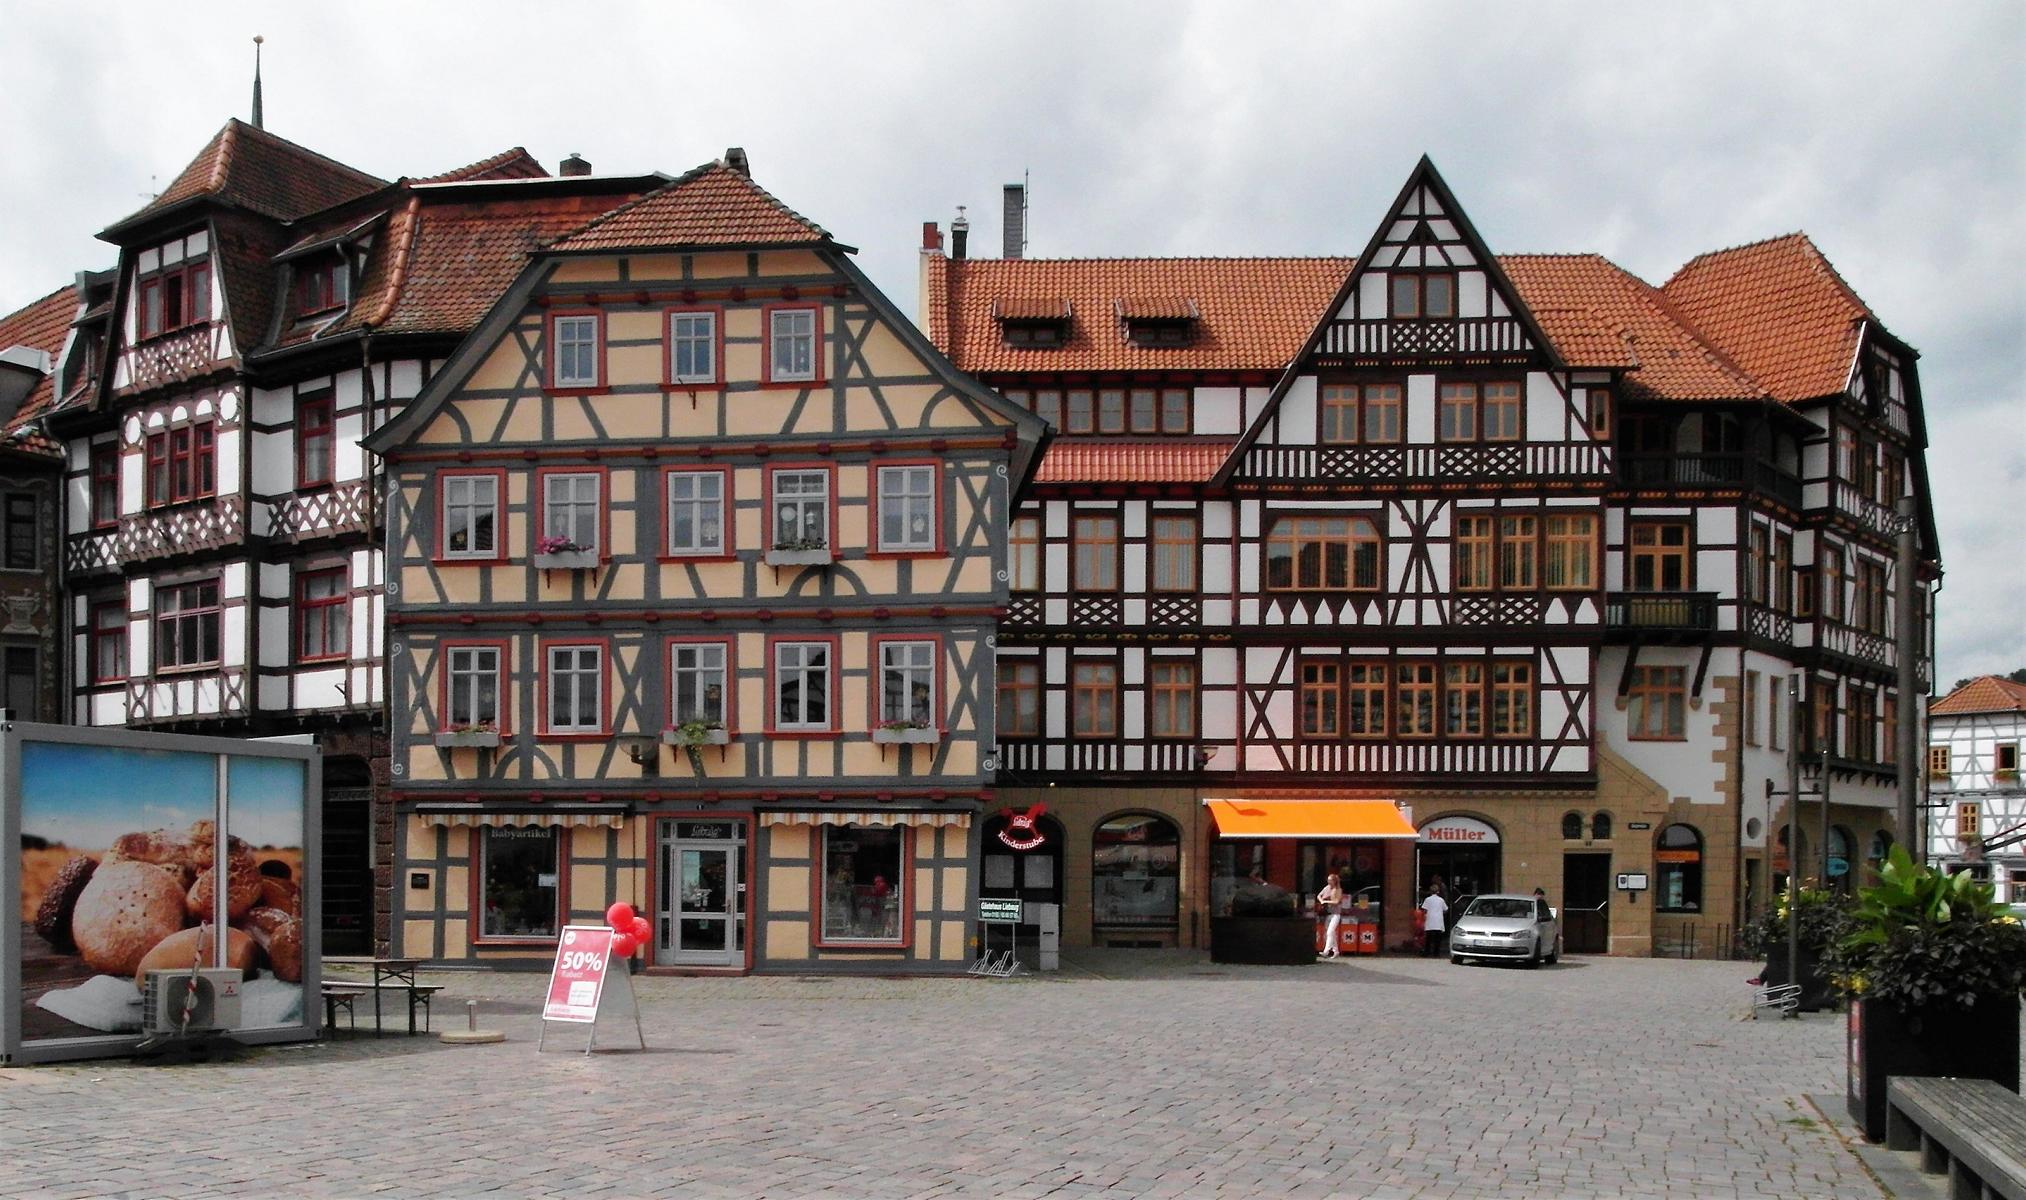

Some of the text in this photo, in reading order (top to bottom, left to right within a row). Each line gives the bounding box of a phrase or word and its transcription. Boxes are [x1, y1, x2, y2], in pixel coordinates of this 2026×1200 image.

[491, 829, 551, 840] Babyartikel
[998, 830, 1046, 850] Kinderstube
[1428, 828, 1485, 841] Müller
[560, 951, 603, 971] 50%
